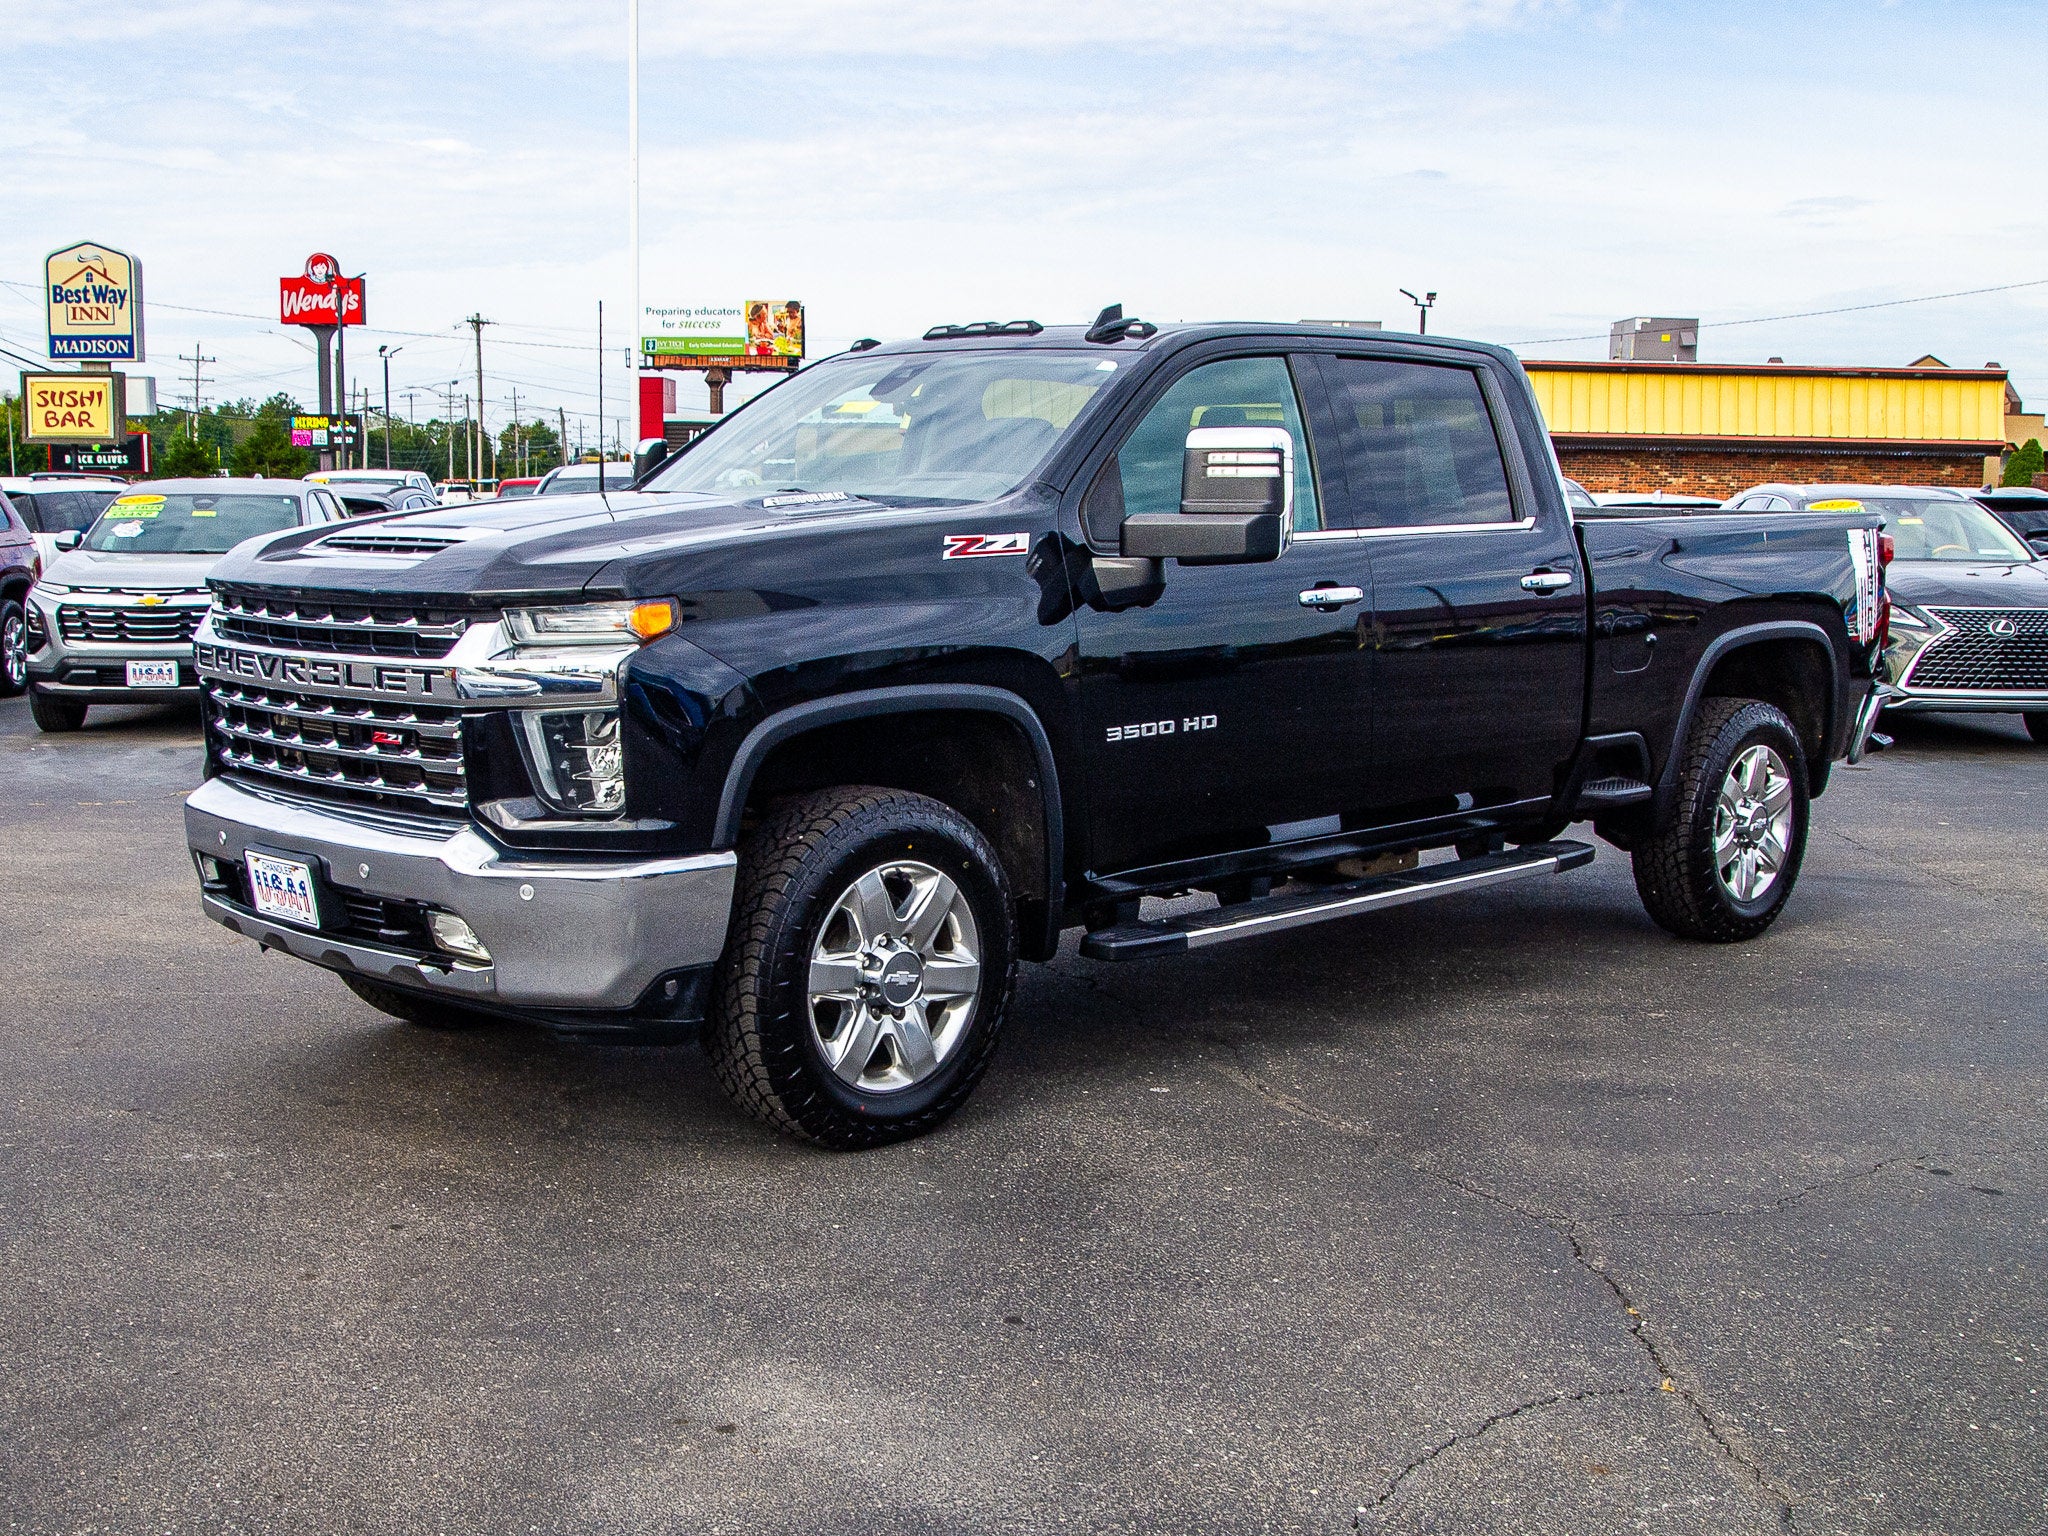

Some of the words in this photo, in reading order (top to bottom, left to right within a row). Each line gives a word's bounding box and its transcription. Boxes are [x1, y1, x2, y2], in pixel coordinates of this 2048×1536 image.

[52, 285, 90, 303] Best
[92, 285, 127, 309] Way
[283, 284, 359, 317] Wendy's
[71, 307, 109, 321] INN
[646, 307, 691, 318] Preparing
[694, 307, 741, 316] educators
[662, 320, 675, 329] for
[678, 321, 721, 329] success
[54, 340, 129, 354] MADISON
[36, 390, 103, 408] SUSHI
[44, 410, 95, 428] BAR
[97, 454, 129, 464] OLIVES
[197, 644, 446, 696] CHEVROLET
[1106, 720, 1175, 742] 3500
[1183, 715, 1217, 732] HD
